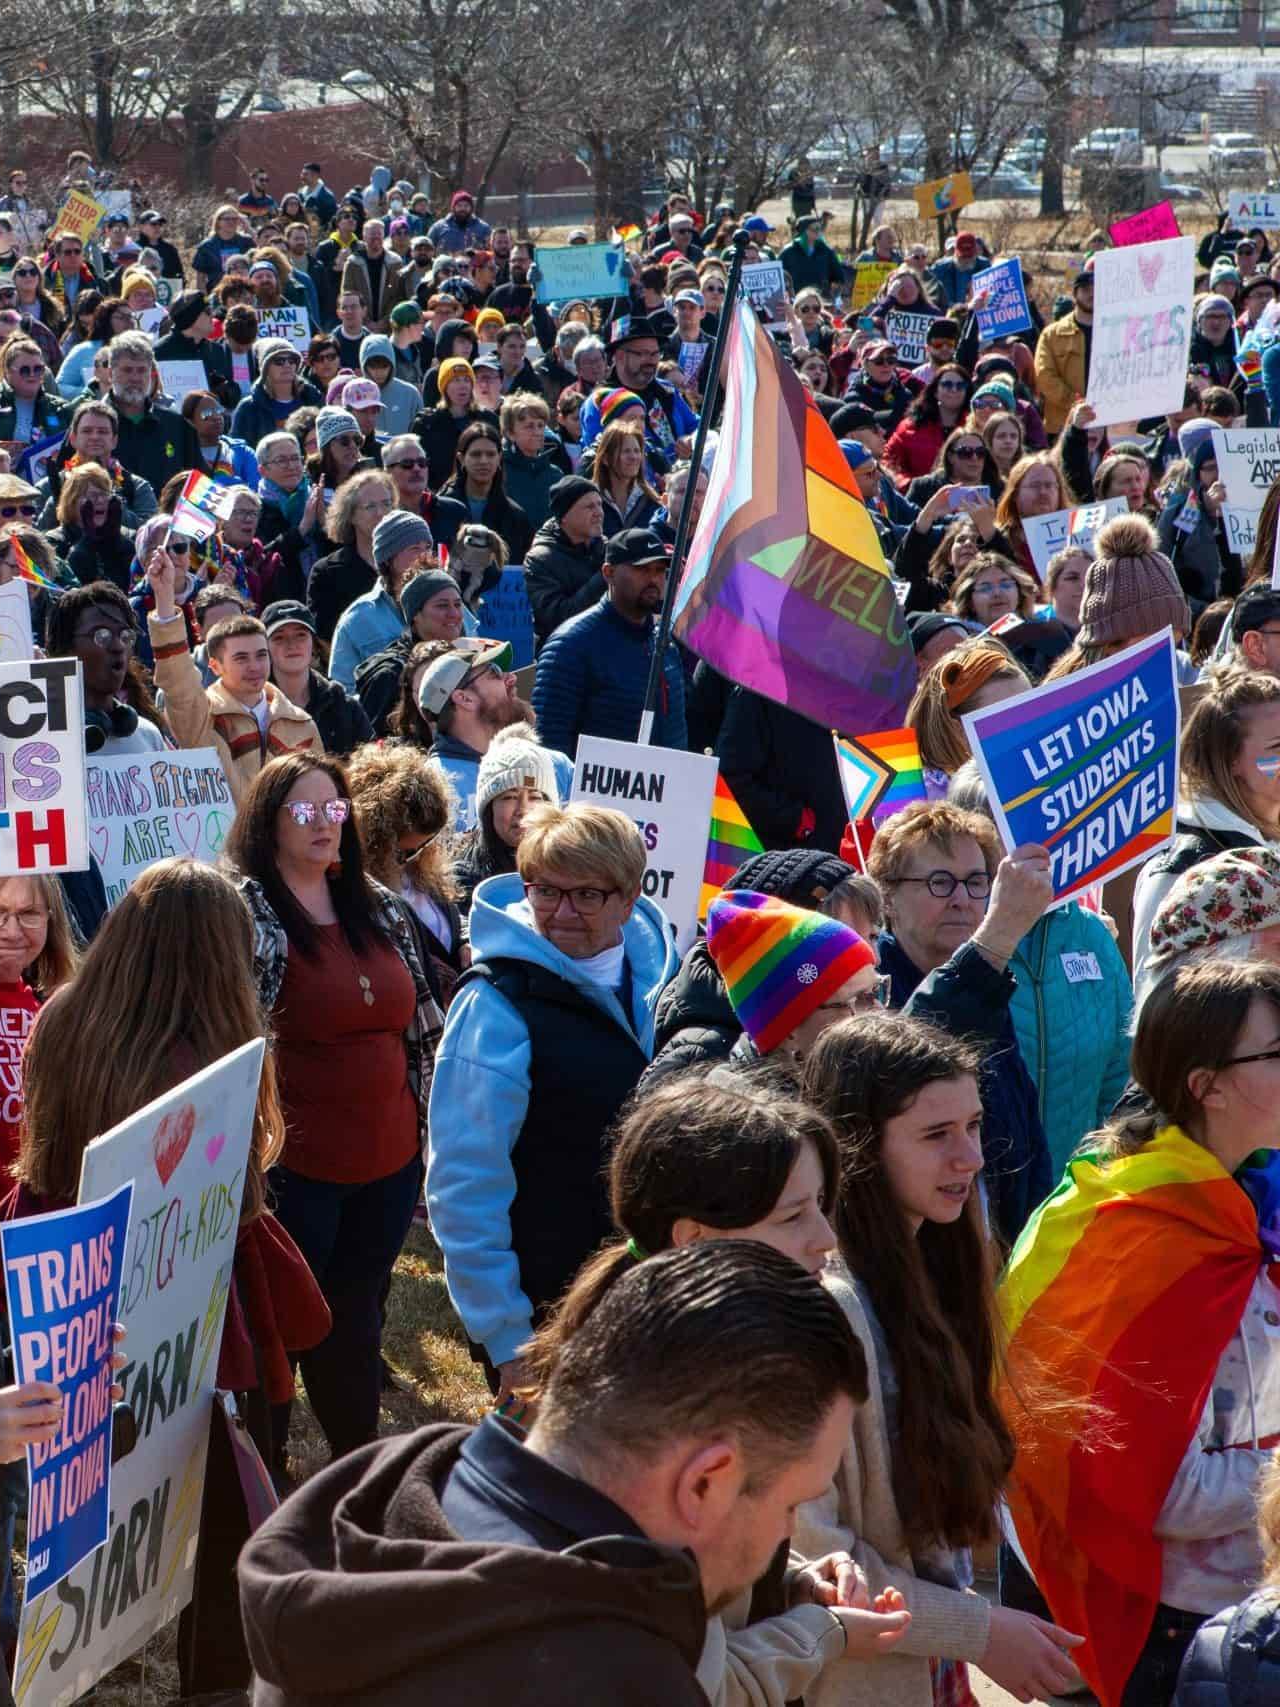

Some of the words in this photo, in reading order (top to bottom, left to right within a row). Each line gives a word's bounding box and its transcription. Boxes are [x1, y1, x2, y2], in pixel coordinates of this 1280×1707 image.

[65, 198, 99, 219] STOP
[1238, 202, 1275, 217] ALL
[1022, 724, 1076, 782] LET
[1077, 676, 1150, 750] IOWA
[1040, 719, 1156, 833] STUDENTS
[87, 764, 152, 819] RANS
[150, 760, 230, 809] RIGHTS
[580, 763, 665, 803] HUMAN
[1045, 761, 1168, 888] THRIVE!
[122, 815, 176, 866] ARE
[192, 1167, 242, 1264] KIDS
[7, 1225, 115, 1319] TRANS
[30, 1471, 56, 1543] IN
[58, 1431, 106, 1524] IOWA
